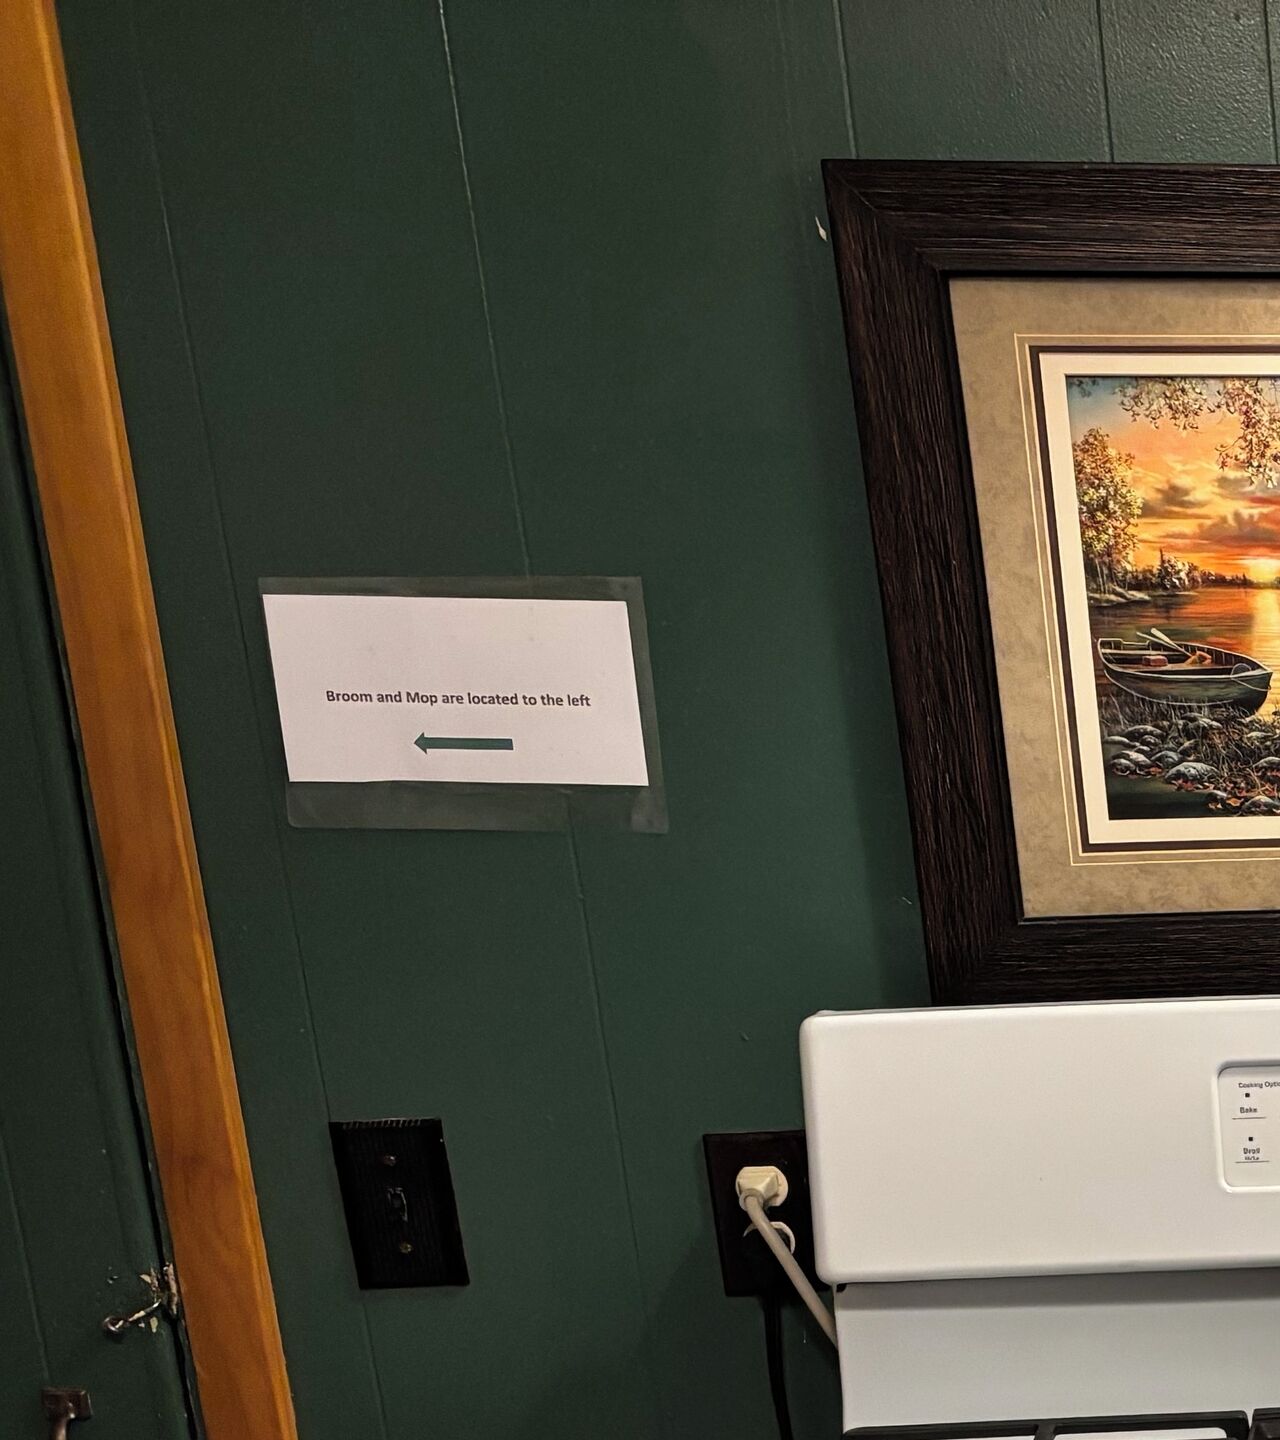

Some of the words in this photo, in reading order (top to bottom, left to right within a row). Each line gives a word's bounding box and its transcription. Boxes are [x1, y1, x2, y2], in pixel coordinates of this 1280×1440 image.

[326, 690, 373, 704] Broom
[377, 691, 402, 704] and
[406, 692, 438, 707] Mop
[442, 694, 464, 705] are
[467, 692, 518, 706] located
[522, 694, 537, 706] to
[540, 693, 564, 707] the
[567, 693, 591, 707] left
